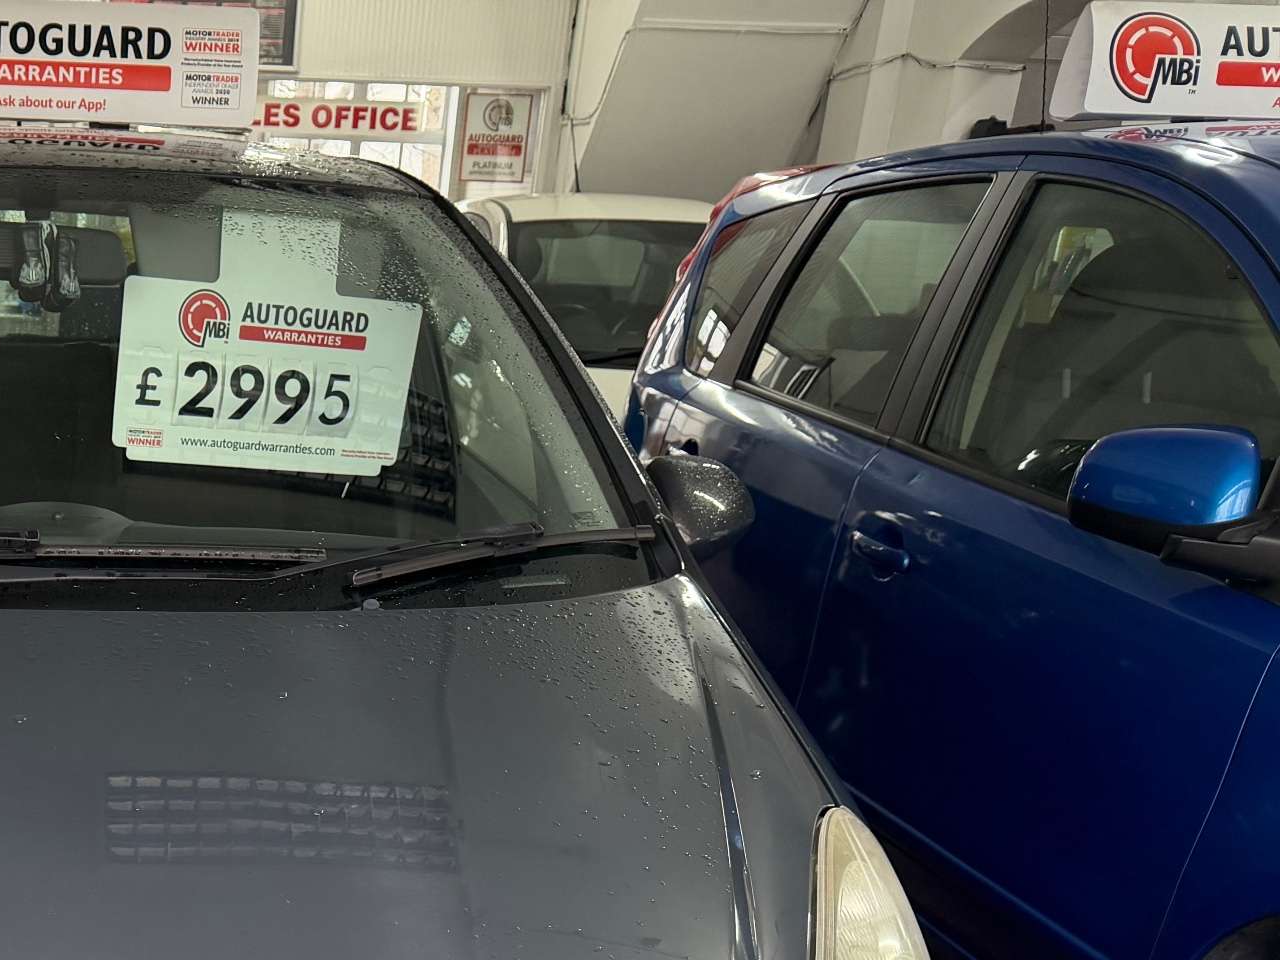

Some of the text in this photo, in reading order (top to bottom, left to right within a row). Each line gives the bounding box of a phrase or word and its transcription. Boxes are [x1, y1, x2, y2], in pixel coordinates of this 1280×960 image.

[184, 41, 240, 53] WINNER
[18, 96, 53, 109] about
[56, 99, 76, 110] our
[78, 98, 107, 112] App!
[191, 95, 230, 106] WINNER
[311, 103, 418, 131] OFFICE
[468, 133, 524, 143] AUTOGUARD
[241, 302, 369, 333] AUTOGUARD
[263, 329, 342, 347] WARRANTIES
[180, 436, 336, 457] www.autoguardwarranties.com
